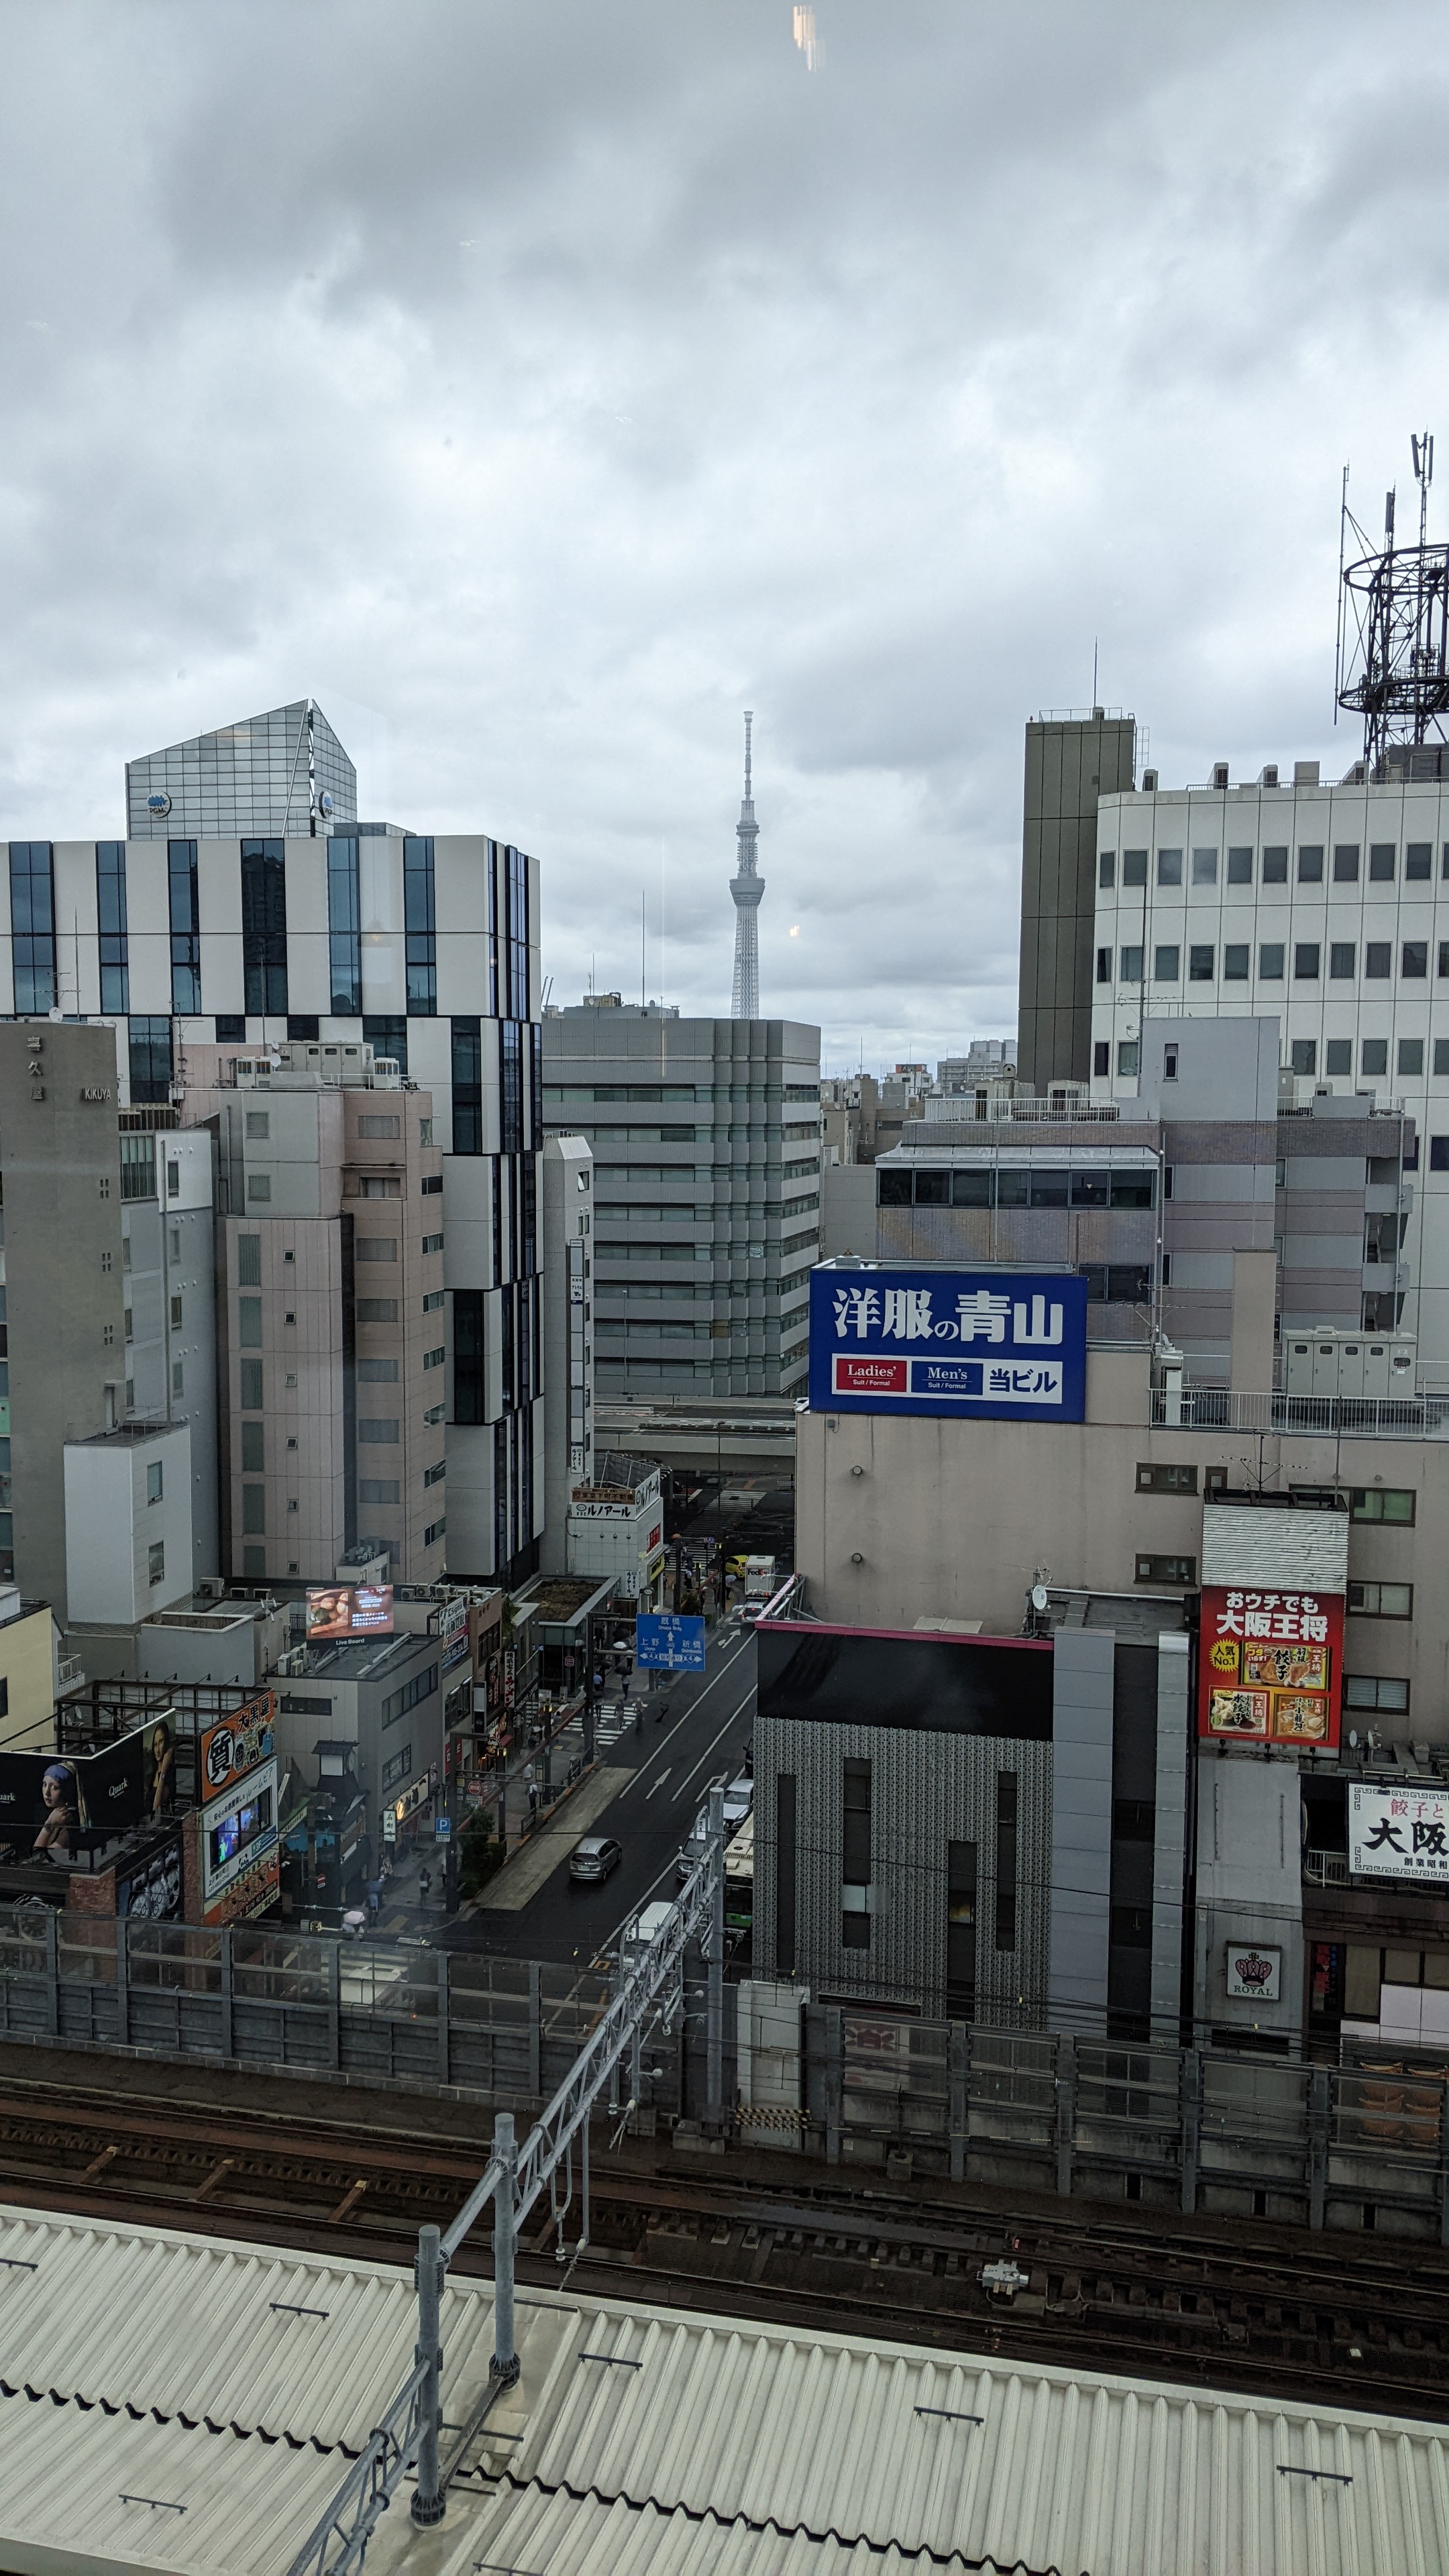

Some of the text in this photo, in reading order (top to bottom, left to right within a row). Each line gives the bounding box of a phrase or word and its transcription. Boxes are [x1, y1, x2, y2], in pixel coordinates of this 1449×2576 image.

[27, 1036, 44, 1100] 喜久屋
[85, 1088, 111, 1100] KIKUYA
[832, 1287, 1064, 1346] 洋服の青山
[989, 1368, 1058, 1393] 当ビル
[641, 1475, 661, 1507] ルノアール
[588, 1505, 631, 1519] ルノアール
[1226, 1592, 1319, 1614] おウチでも
[1216, 1609, 1328, 1642] 大阪王将
[347, 1638, 365, 1646] Board
[640, 1638, 659, 1647] 上野
[682, 1640, 701, 1649] 新橋
[1215, 1646, 1236, 1656] 人気
[1214, 1656, 1236, 1667] No.1
[1274, 1650, 1291, 1681] 餃子
[1311, 1654, 1322, 1672] 王将
[238, 1695, 270, 1731] 大黒屋
[1233, 1693, 1246, 1725] 水餃子
[1254, 1701, 1264, 1717] 王将
[209, 1731, 233, 1785] 質
[109, 1778, 128, 1798] Quark
[246, 1766, 273, 1803] ルームピア
[1391, 1798, 1444, 1819] 餃子と
[439, 1820, 447, 1831] P
[1361, 1817, 1449, 1857] 大阪
[1404, 1857, 1448, 1870] 創業昭和
[1233, 1985, 1274, 1997] ROYAL
